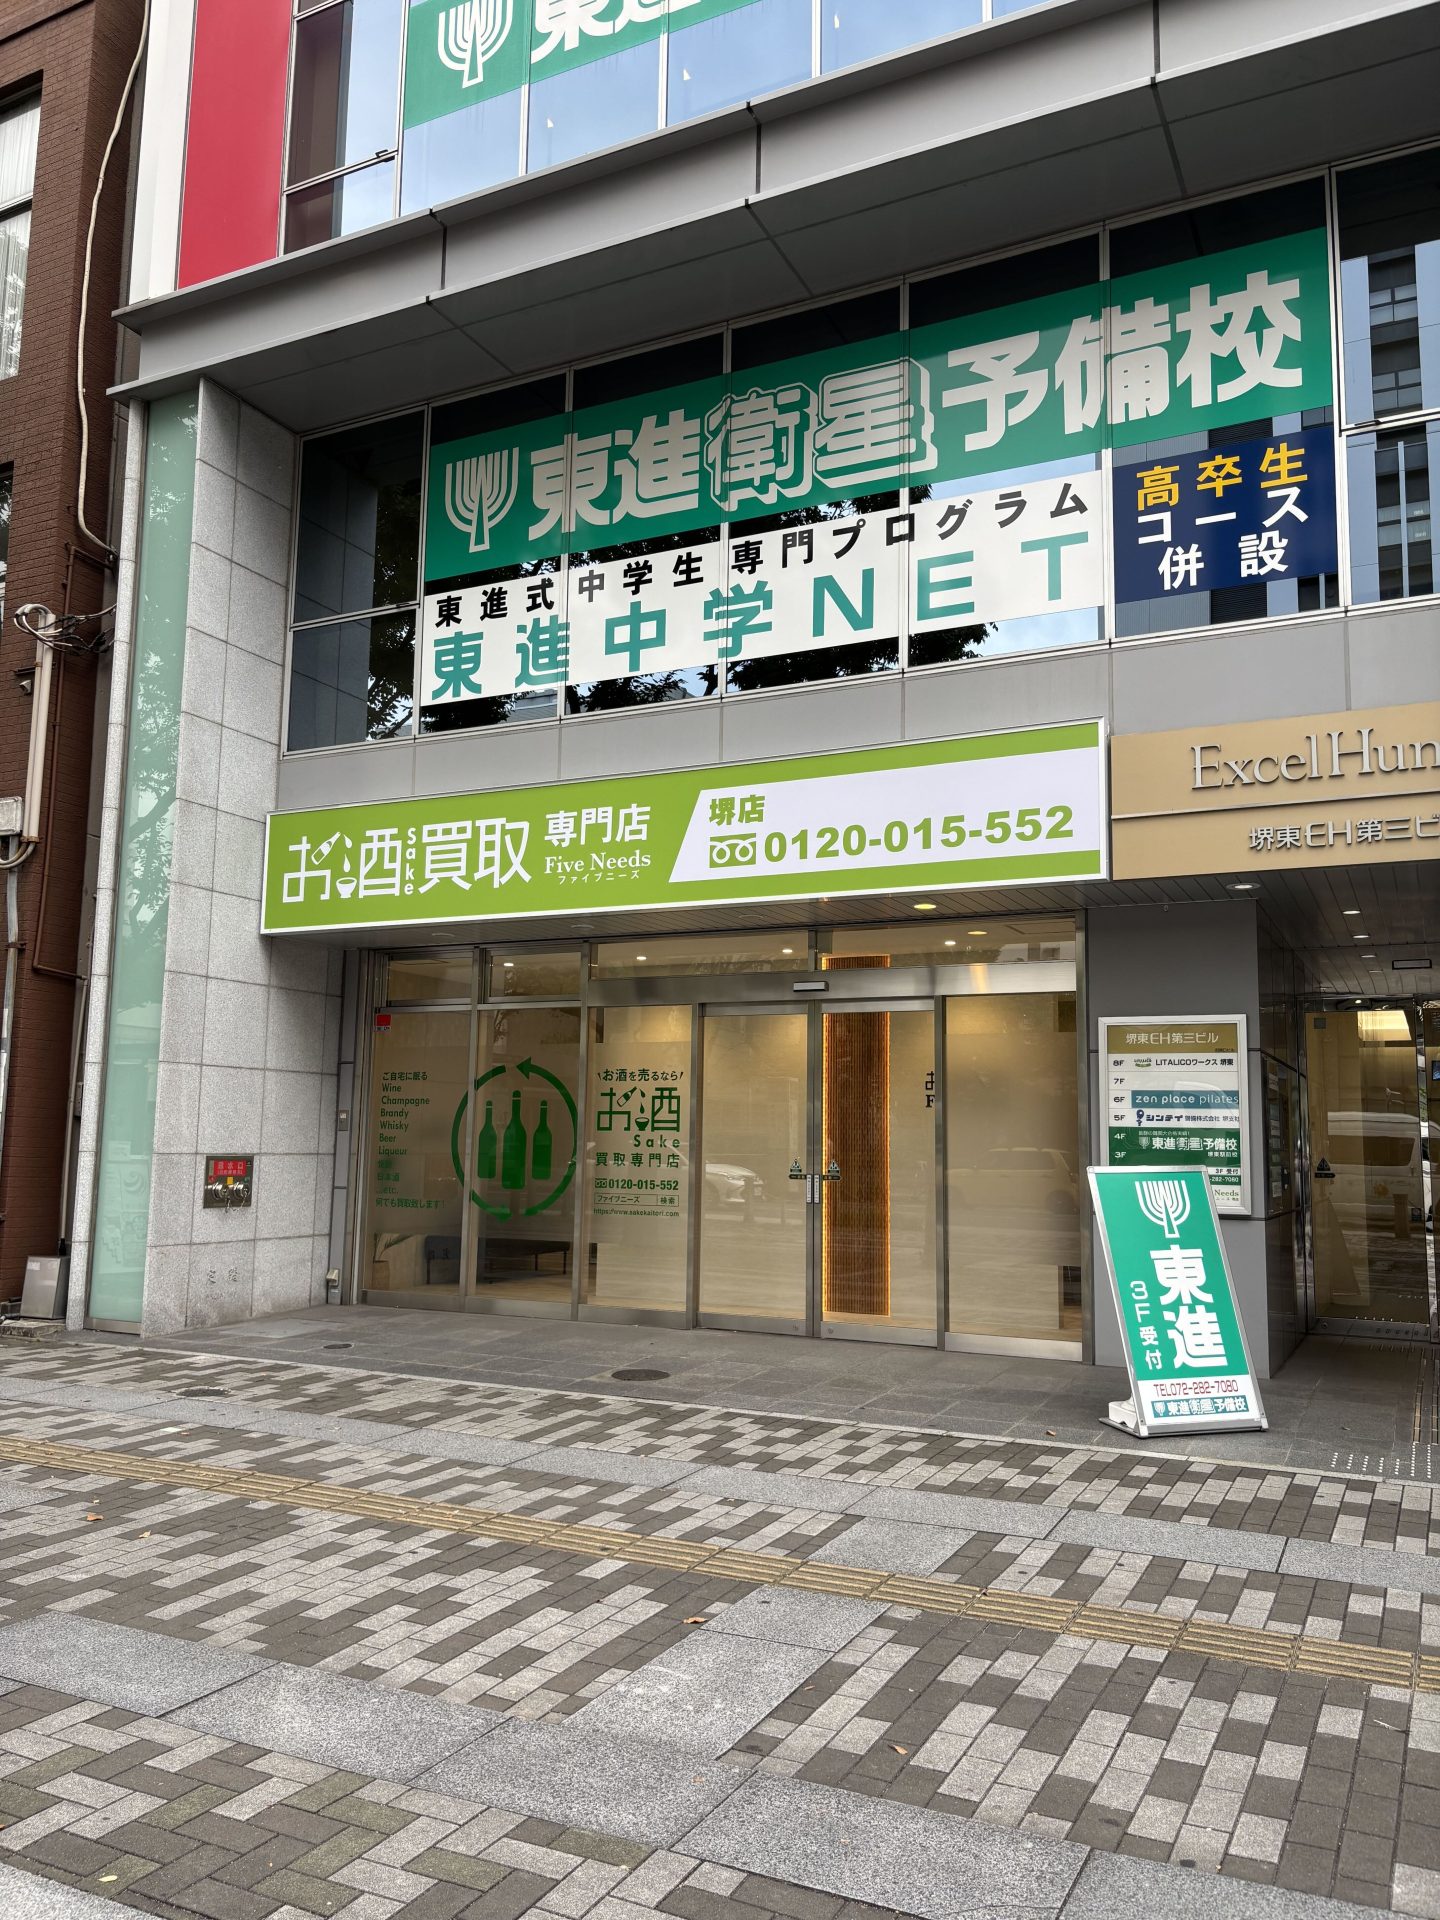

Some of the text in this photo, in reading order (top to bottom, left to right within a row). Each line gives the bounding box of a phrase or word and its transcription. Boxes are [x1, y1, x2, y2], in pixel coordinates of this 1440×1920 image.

[530, 270, 1304, 542] 東進衛星予備校
[1136, 442, 1308, 511] 高卒生
[1137, 486, 1309, 545] コース
[1158, 529, 1289, 590] 併設
[709, 794, 765, 826] 堺店
[544, 803, 651, 848] 専門店
[764, 805, 1074, 862] 0120-015-552
[404, 827, 417, 896] Sake
[418, 817, 532, 894] 買取
[544, 849, 651, 874] Five Needs
[282, 827, 402, 903] お酒
[558, 869, 640, 885] ファイブニーズ
[1125, 1032, 1219, 1046] 堺東EH第三ビル
[1155, 1058, 1218, 1066] LITALICOワークス
[1220, 1058, 1234, 1066] 堺東
[382, 1083, 402, 1092] Wine
[381, 1095, 430, 1107] Champagne
[1136, 1095, 1158, 1103] zen
[1161, 1094, 1196, 1105] place
[1199, 1093, 1239, 1105] pilates
[380, 1108, 409, 1119] Brandy
[597, 1086, 681, 1132] お酒
[379, 1120, 409, 1132] Whisky
[1146, 1114, 1184, 1122] シンテイ
[379, 1133, 397, 1143] Beer
[633, 1134, 681, 1148] Sake
[1151, 1137, 1238, 1151] 東進衛星予備校
[378, 1145, 408, 1157] Liqueur
[1114, 1151, 1127, 1159] 3F
[595, 1152, 680, 1168] 買取専門店
[608, 1179, 679, 1190] 0120-015-552
[660, 1196, 676, 1205] 検索
[1214, 1189, 1239, 1197] Needs
[1149, 1244, 1228, 1369] 東進
[1129, 1280, 1163, 1370] 3F受付
[1153, 1379, 1239, 1397] TEL072-282-7080
[1167, 1397, 1248, 1416] 東進衛星予備校
